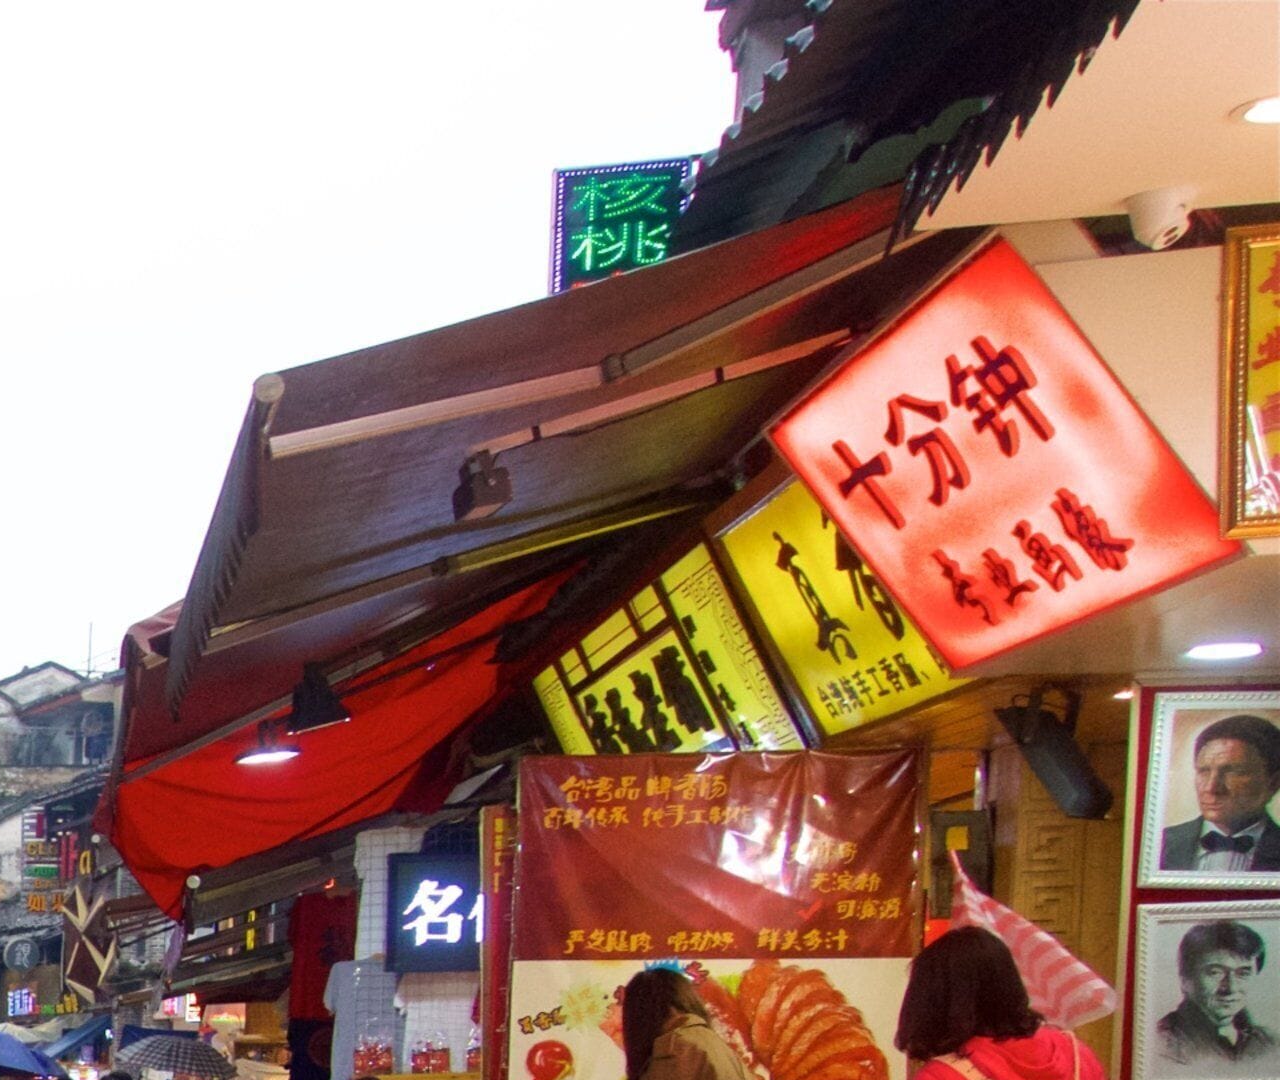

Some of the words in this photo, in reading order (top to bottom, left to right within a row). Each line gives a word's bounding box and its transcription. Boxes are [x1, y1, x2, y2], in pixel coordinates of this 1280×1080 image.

[572, 173, 672, 271] 核桃
[831, 334, 1057, 531] 十分钟
